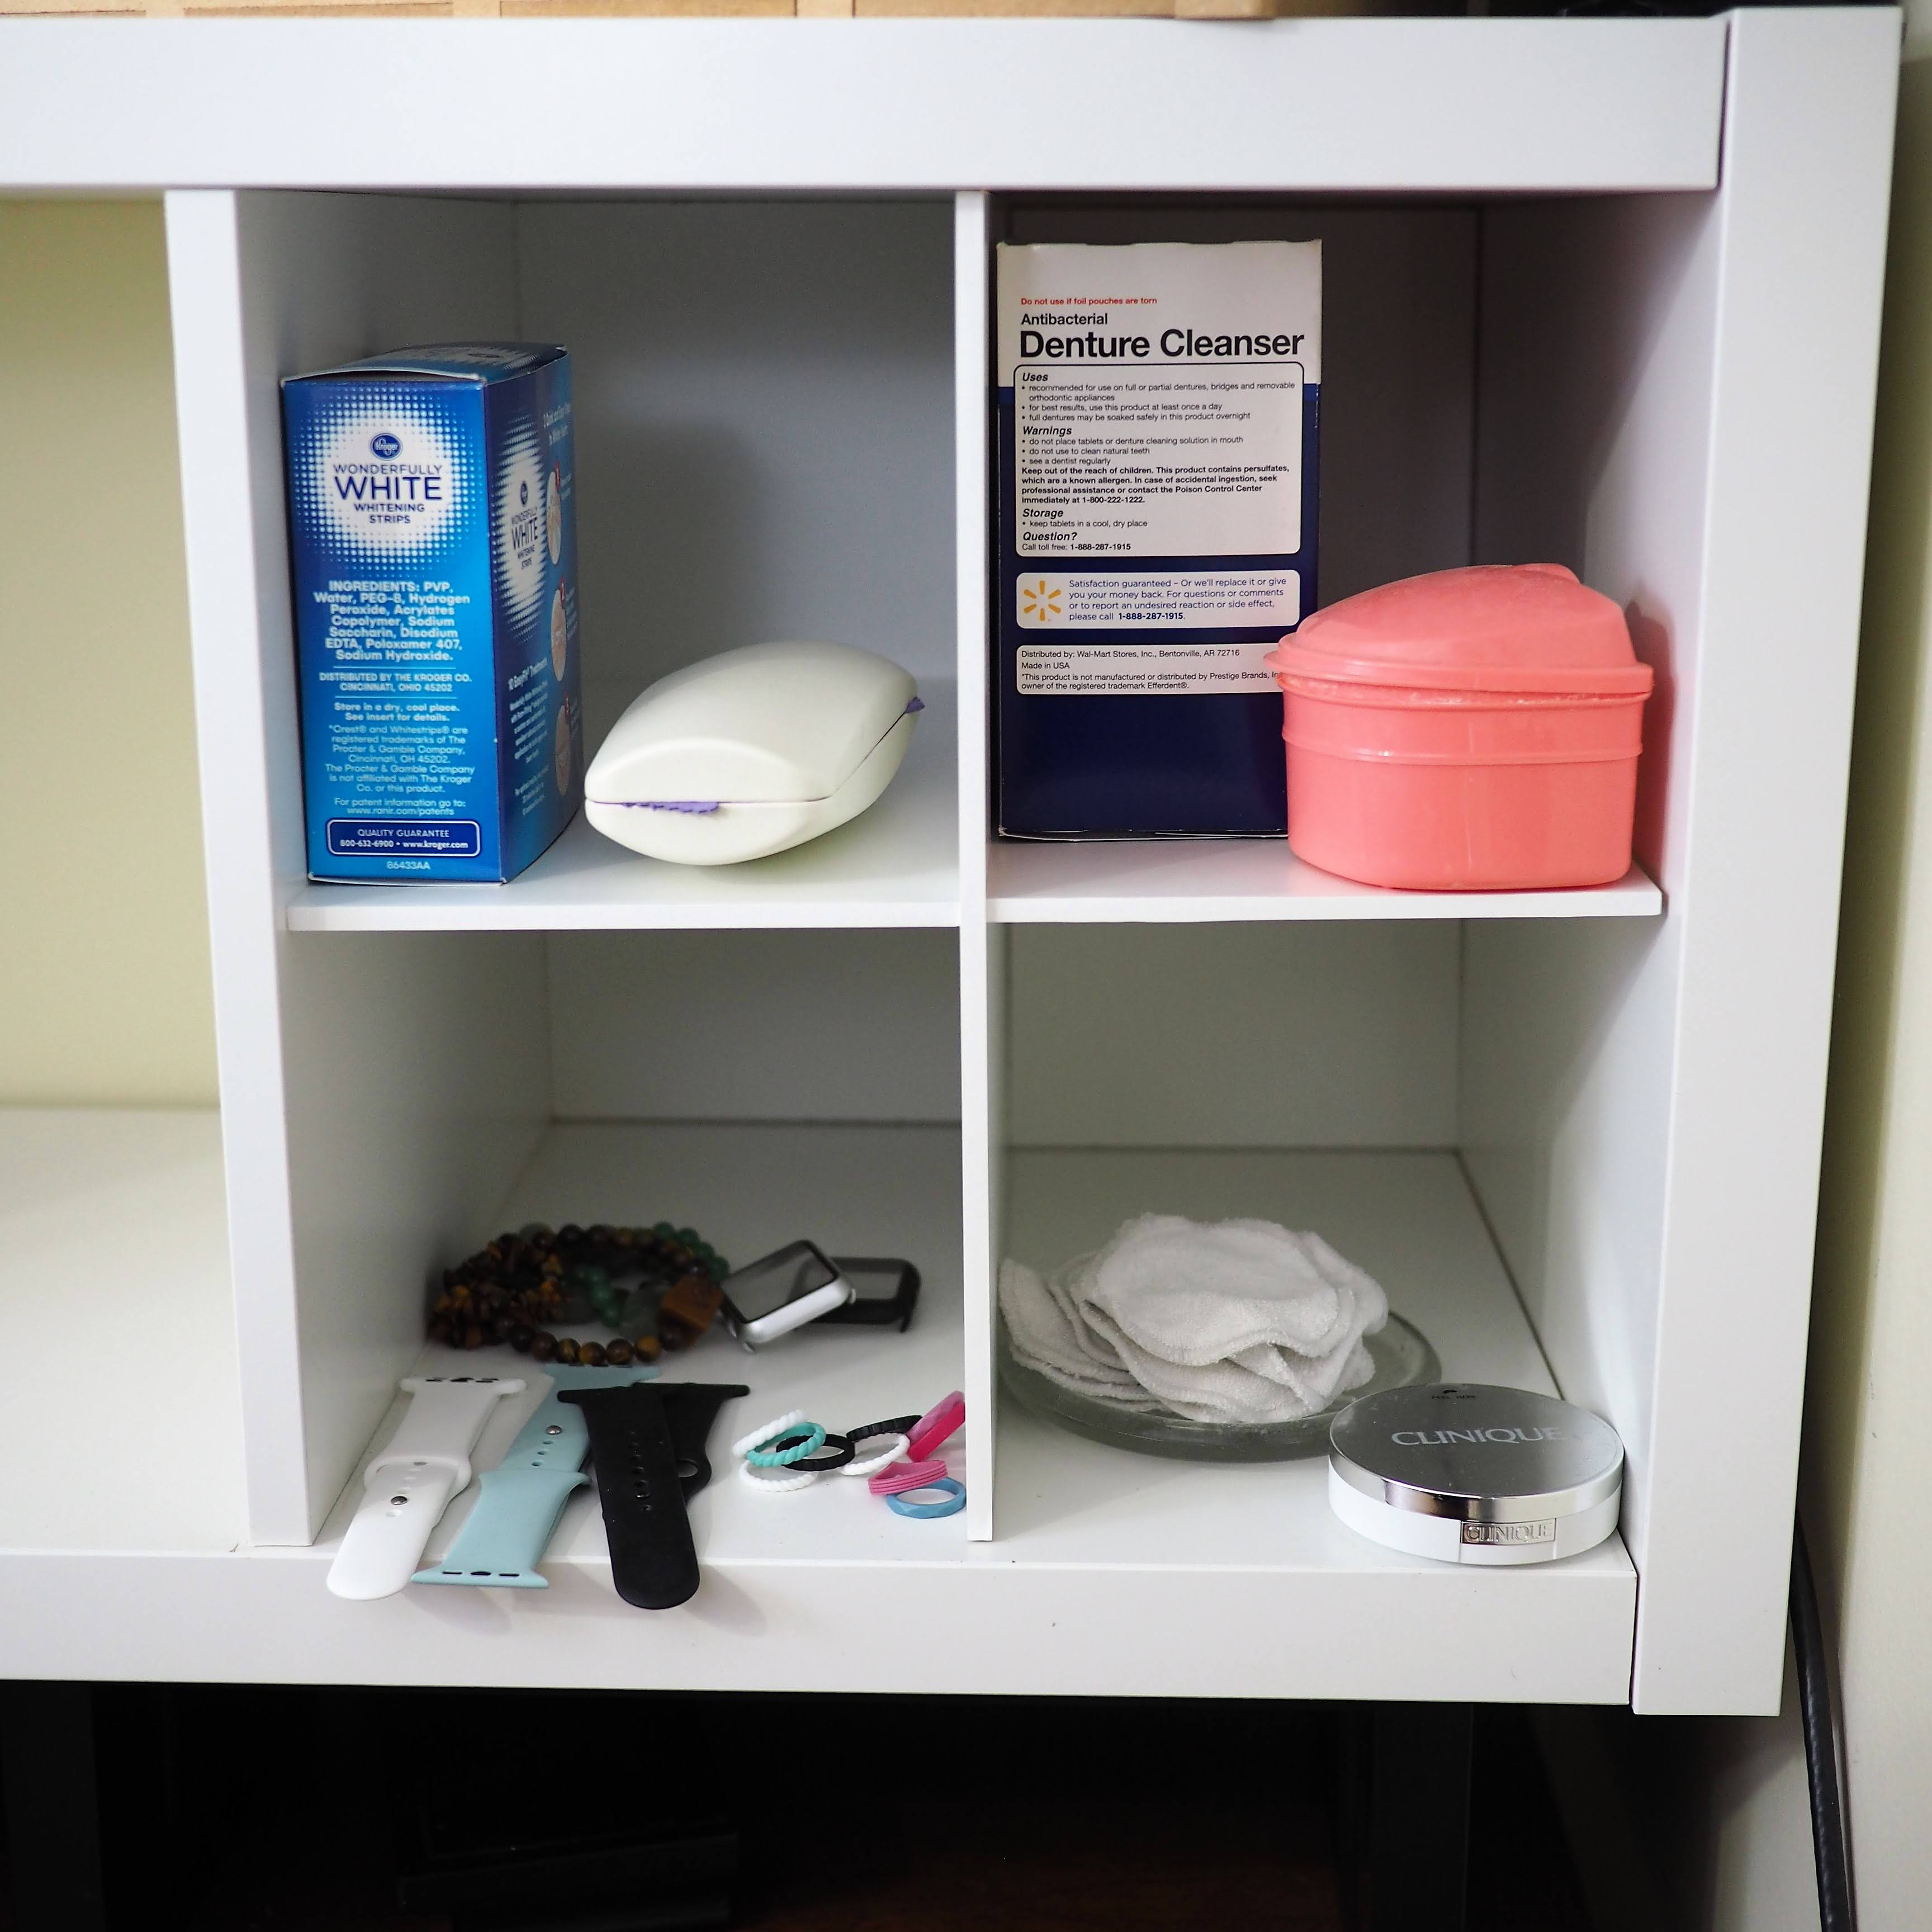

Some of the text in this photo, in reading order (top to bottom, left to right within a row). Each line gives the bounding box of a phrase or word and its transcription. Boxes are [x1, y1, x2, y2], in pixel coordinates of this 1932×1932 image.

[1021, 312, 1107, 325] Antibacterial
[1020, 328, 1305, 358] Denture Cleanser
[1022, 372, 1048, 381] Uses
[1148, 383, 1172, 392] partial
[1210, 382, 1239, 391] bridges
[1074, 394, 1115, 402] appliances
[1022, 425, 1072, 437] Warnings
[375, 438, 399, 456] Kroger
[333, 464, 442, 475] WONDERFULLY
[1021, 467, 1043, 475] Keep
[1243, 465, 1289, 473] persulfates,
[1097, 476, 1132, 485] allergen.
[1218, 475, 1257, 484] ingestion,
[334, 476, 442, 500] WHITE
[1021, 486, 1071, 495] professional
[1021, 496, 1070, 505] immediately
[353, 503, 425, 512] WHITENING
[369, 515, 410, 523] STRIPS
[1022, 508, 1064, 519] Storage
[512, 517, 538, 550] WHITE
[1022, 532, 1077, 541] Question?
[329, 581, 453, 593] INGREDIENTS: PVP,
[1069, 579, 1119, 588] Satisfaction
[1121, 579, 1171, 588] guaranteed
[1215, 578, 1247, 587] replace
[1268, 577, 1286, 586] give
[314, 593, 470, 605] Water, PEG-8, Hydrogen
[1183, 590, 1225, 599] questions
[330, 604, 455, 616] Peroxide, Acrylates
[331, 615, 455, 627] Copolymer, Sodium
[329, 627, 458, 638] Saccharin, Disodium
[325, 638, 462, 650] EDTA, Poloxamer 407,
[335, 649, 453, 662] Sodium Hydroxide.
[1063, 651, 1074, 659] by:
[334, 703, 361, 711] Store
[402, 840, 468, 850] www.kroger.com
[1391, 1427, 1562, 1445] CLINIQUE
[1466, 1523, 1552, 1543] CLINIQUE
